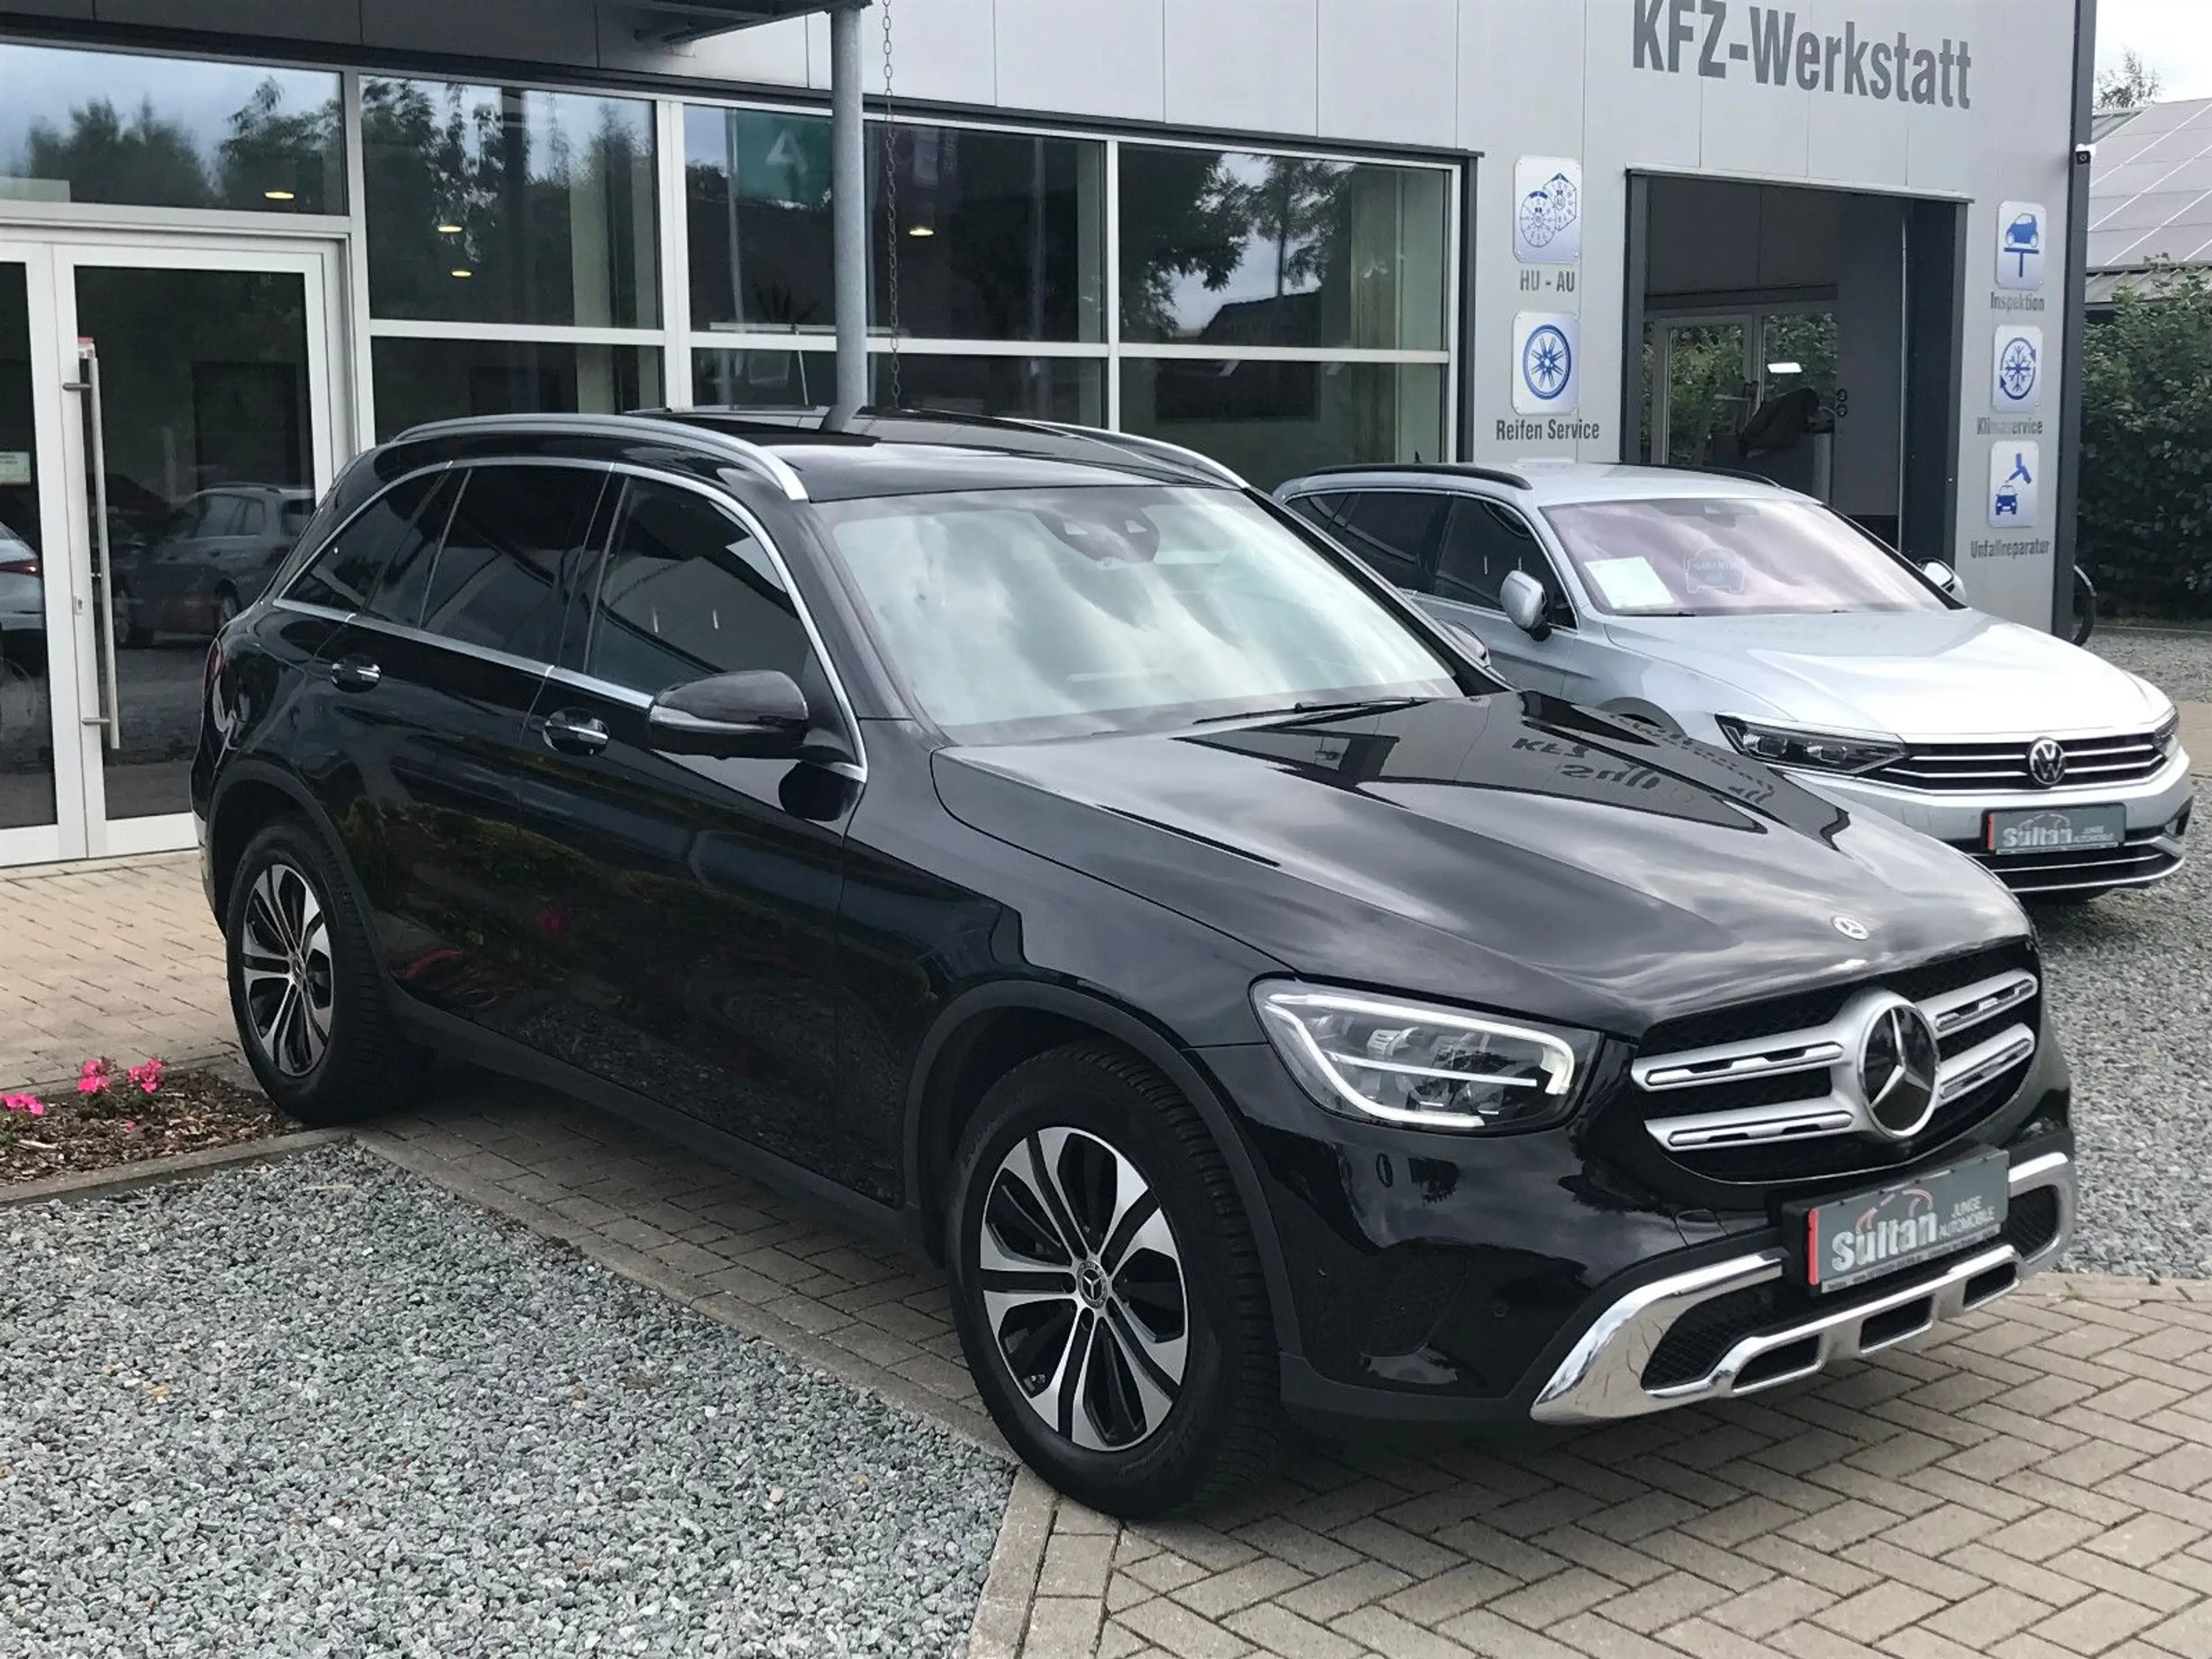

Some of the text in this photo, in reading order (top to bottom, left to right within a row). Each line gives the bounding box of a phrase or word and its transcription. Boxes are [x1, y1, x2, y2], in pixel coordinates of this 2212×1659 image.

[1633, 0, 1971, 109] KFZ-Werkstatt
[1520, 270, 1540, 291] HU
[1556, 271, 1575, 292] AU
[1991, 291, 2044, 313] Inspektion
[1497, 418, 1599, 441] Reifen Service
[1971, 538, 2050, 560] Unfallreparatur
[1831, 1212, 1937, 1272] Sultan
